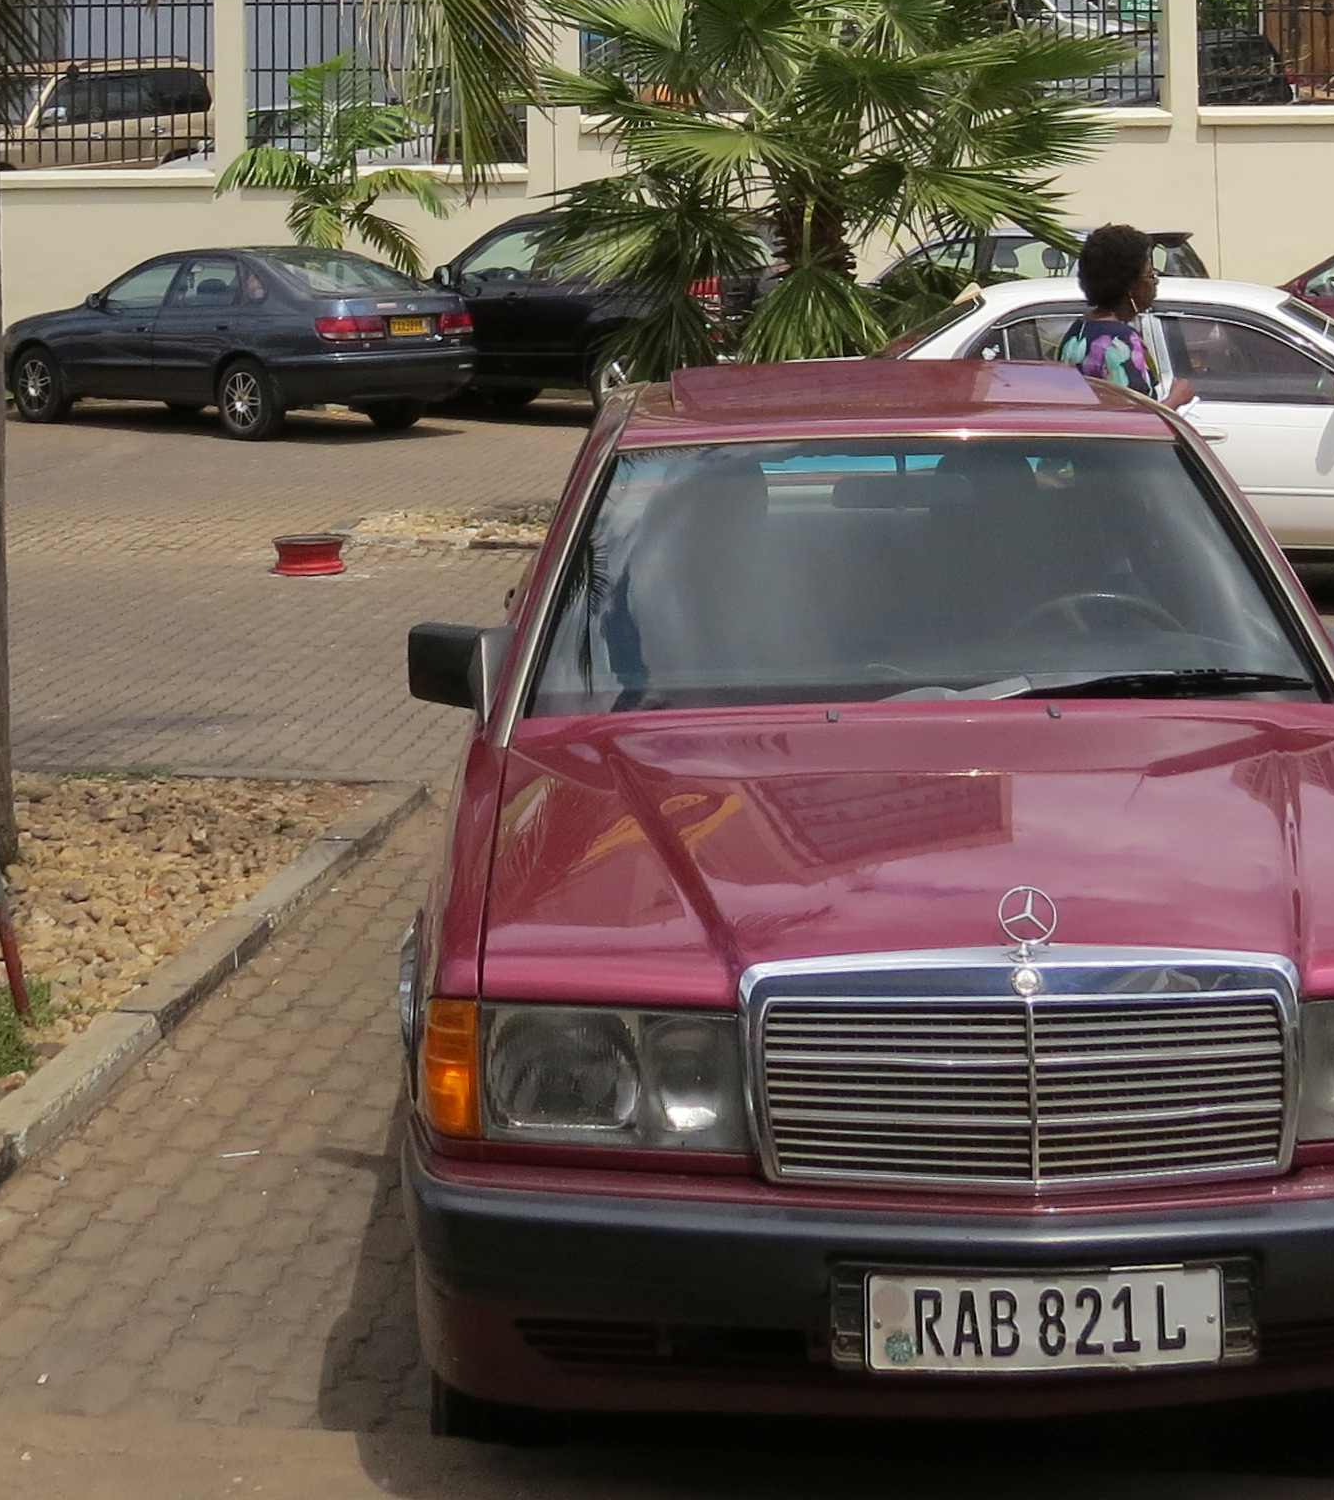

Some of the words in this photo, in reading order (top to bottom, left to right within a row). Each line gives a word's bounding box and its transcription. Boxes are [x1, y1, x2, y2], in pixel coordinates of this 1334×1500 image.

[914, 1288, 1019, 1357] RAB
[1038, 1285, 1141, 1357] 821
[1155, 1284, 1187, 1350] L
